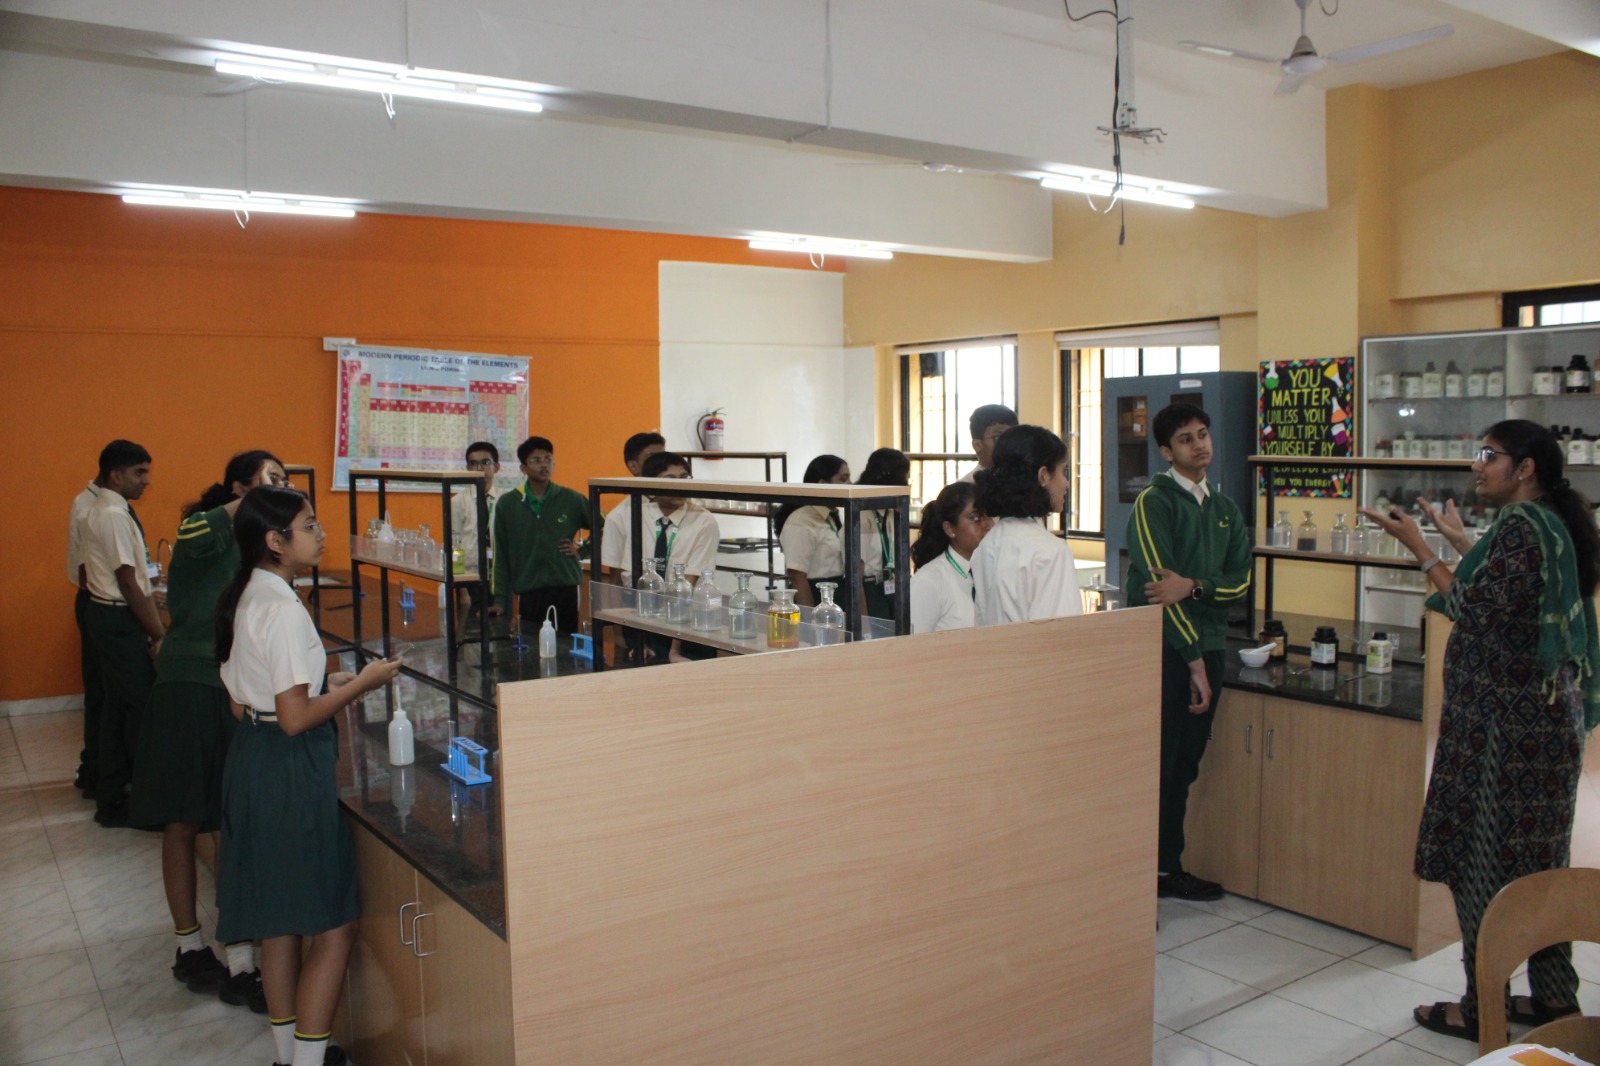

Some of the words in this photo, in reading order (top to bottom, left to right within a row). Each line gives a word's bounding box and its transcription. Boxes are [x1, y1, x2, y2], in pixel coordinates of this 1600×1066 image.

[358, 350, 392, 360] MODERN
[393, 353, 429, 363] PERIODIC
[481, 359, 519, 369] ELEMENTS
[1288, 368, 1321, 388] YOU
[1271, 387, 1331, 407] MATTER
[1266, 408, 1299, 425] UNLESS
[1303, 408, 1326, 424] YOU
[1277, 424, 1329, 440] MULTIPLY
[1265, 440, 1316, 456] YOURSELF
[1321, 441, 1336, 457] BY
